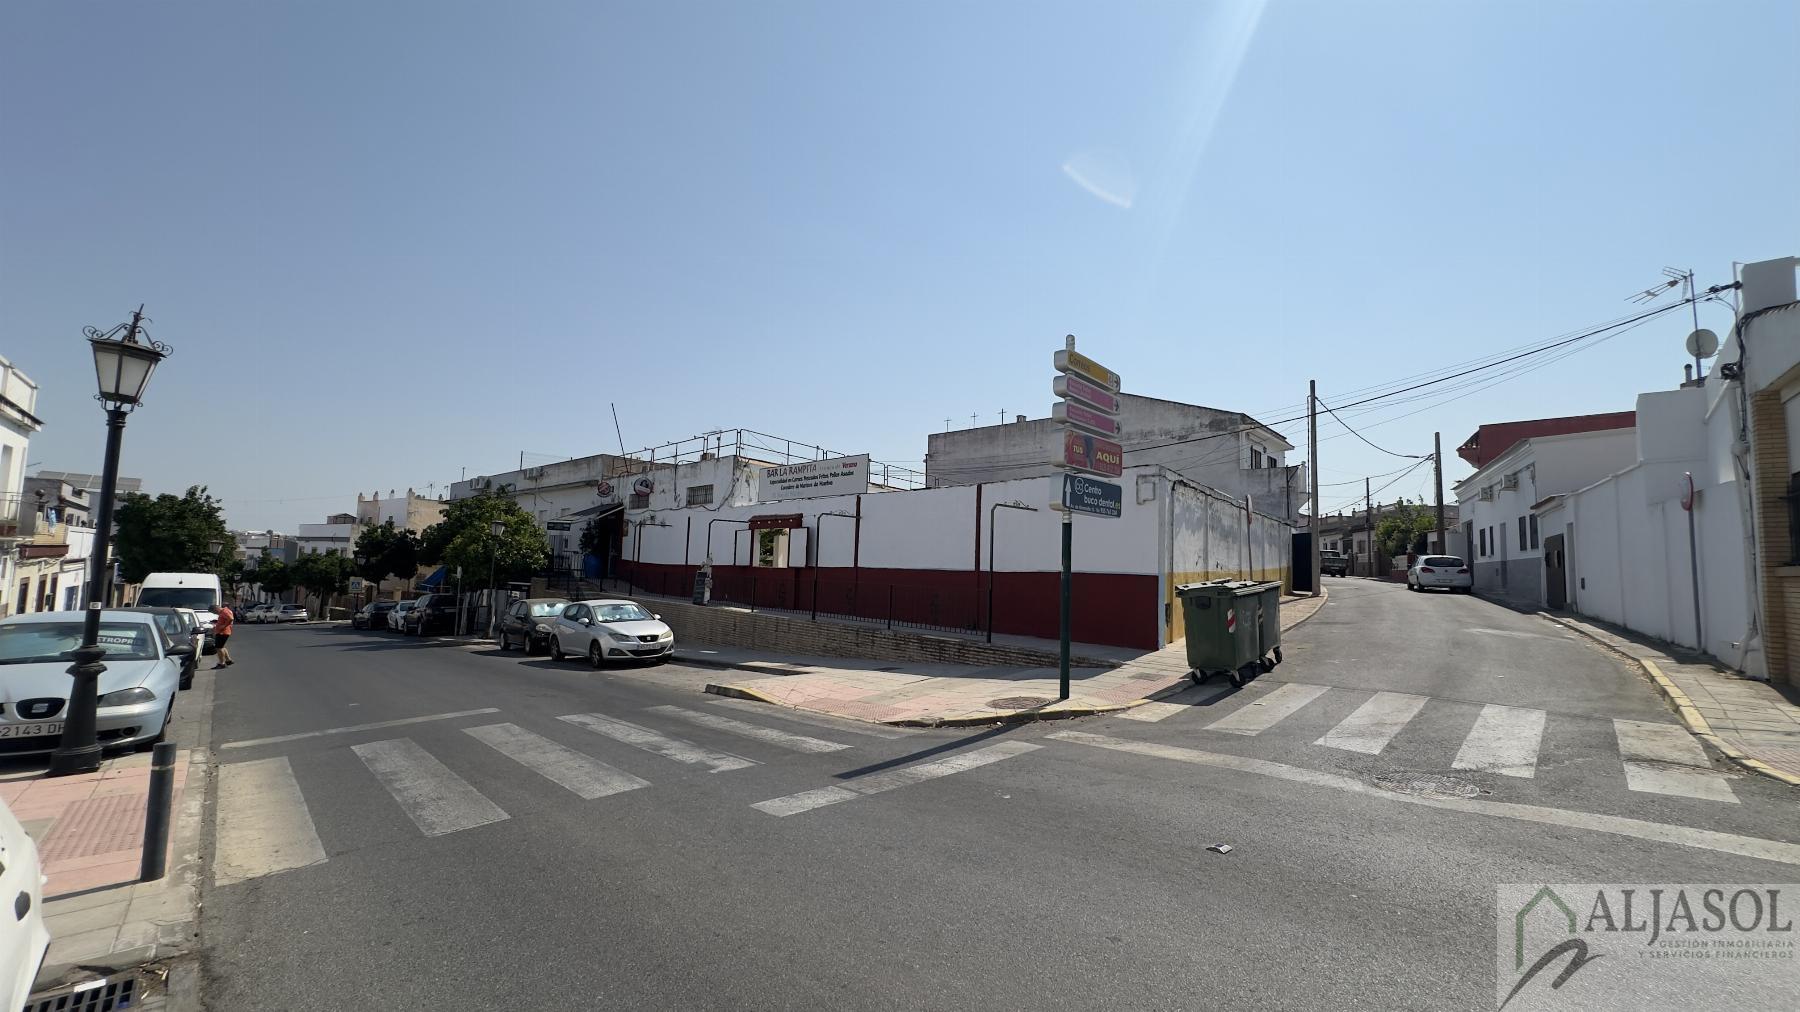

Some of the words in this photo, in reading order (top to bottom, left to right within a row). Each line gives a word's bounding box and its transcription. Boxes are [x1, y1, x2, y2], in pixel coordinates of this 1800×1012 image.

[767, 469, 779, 478] BAR
[780, 468, 788, 477] LA
[789, 464, 817, 475] RAMPITA
[1084, 483, 1102, 495] Centro
[1083, 495, 1098, 506] buco
[1, 724, 42, 737] 2143
[48, 723, 65, 734] DH
